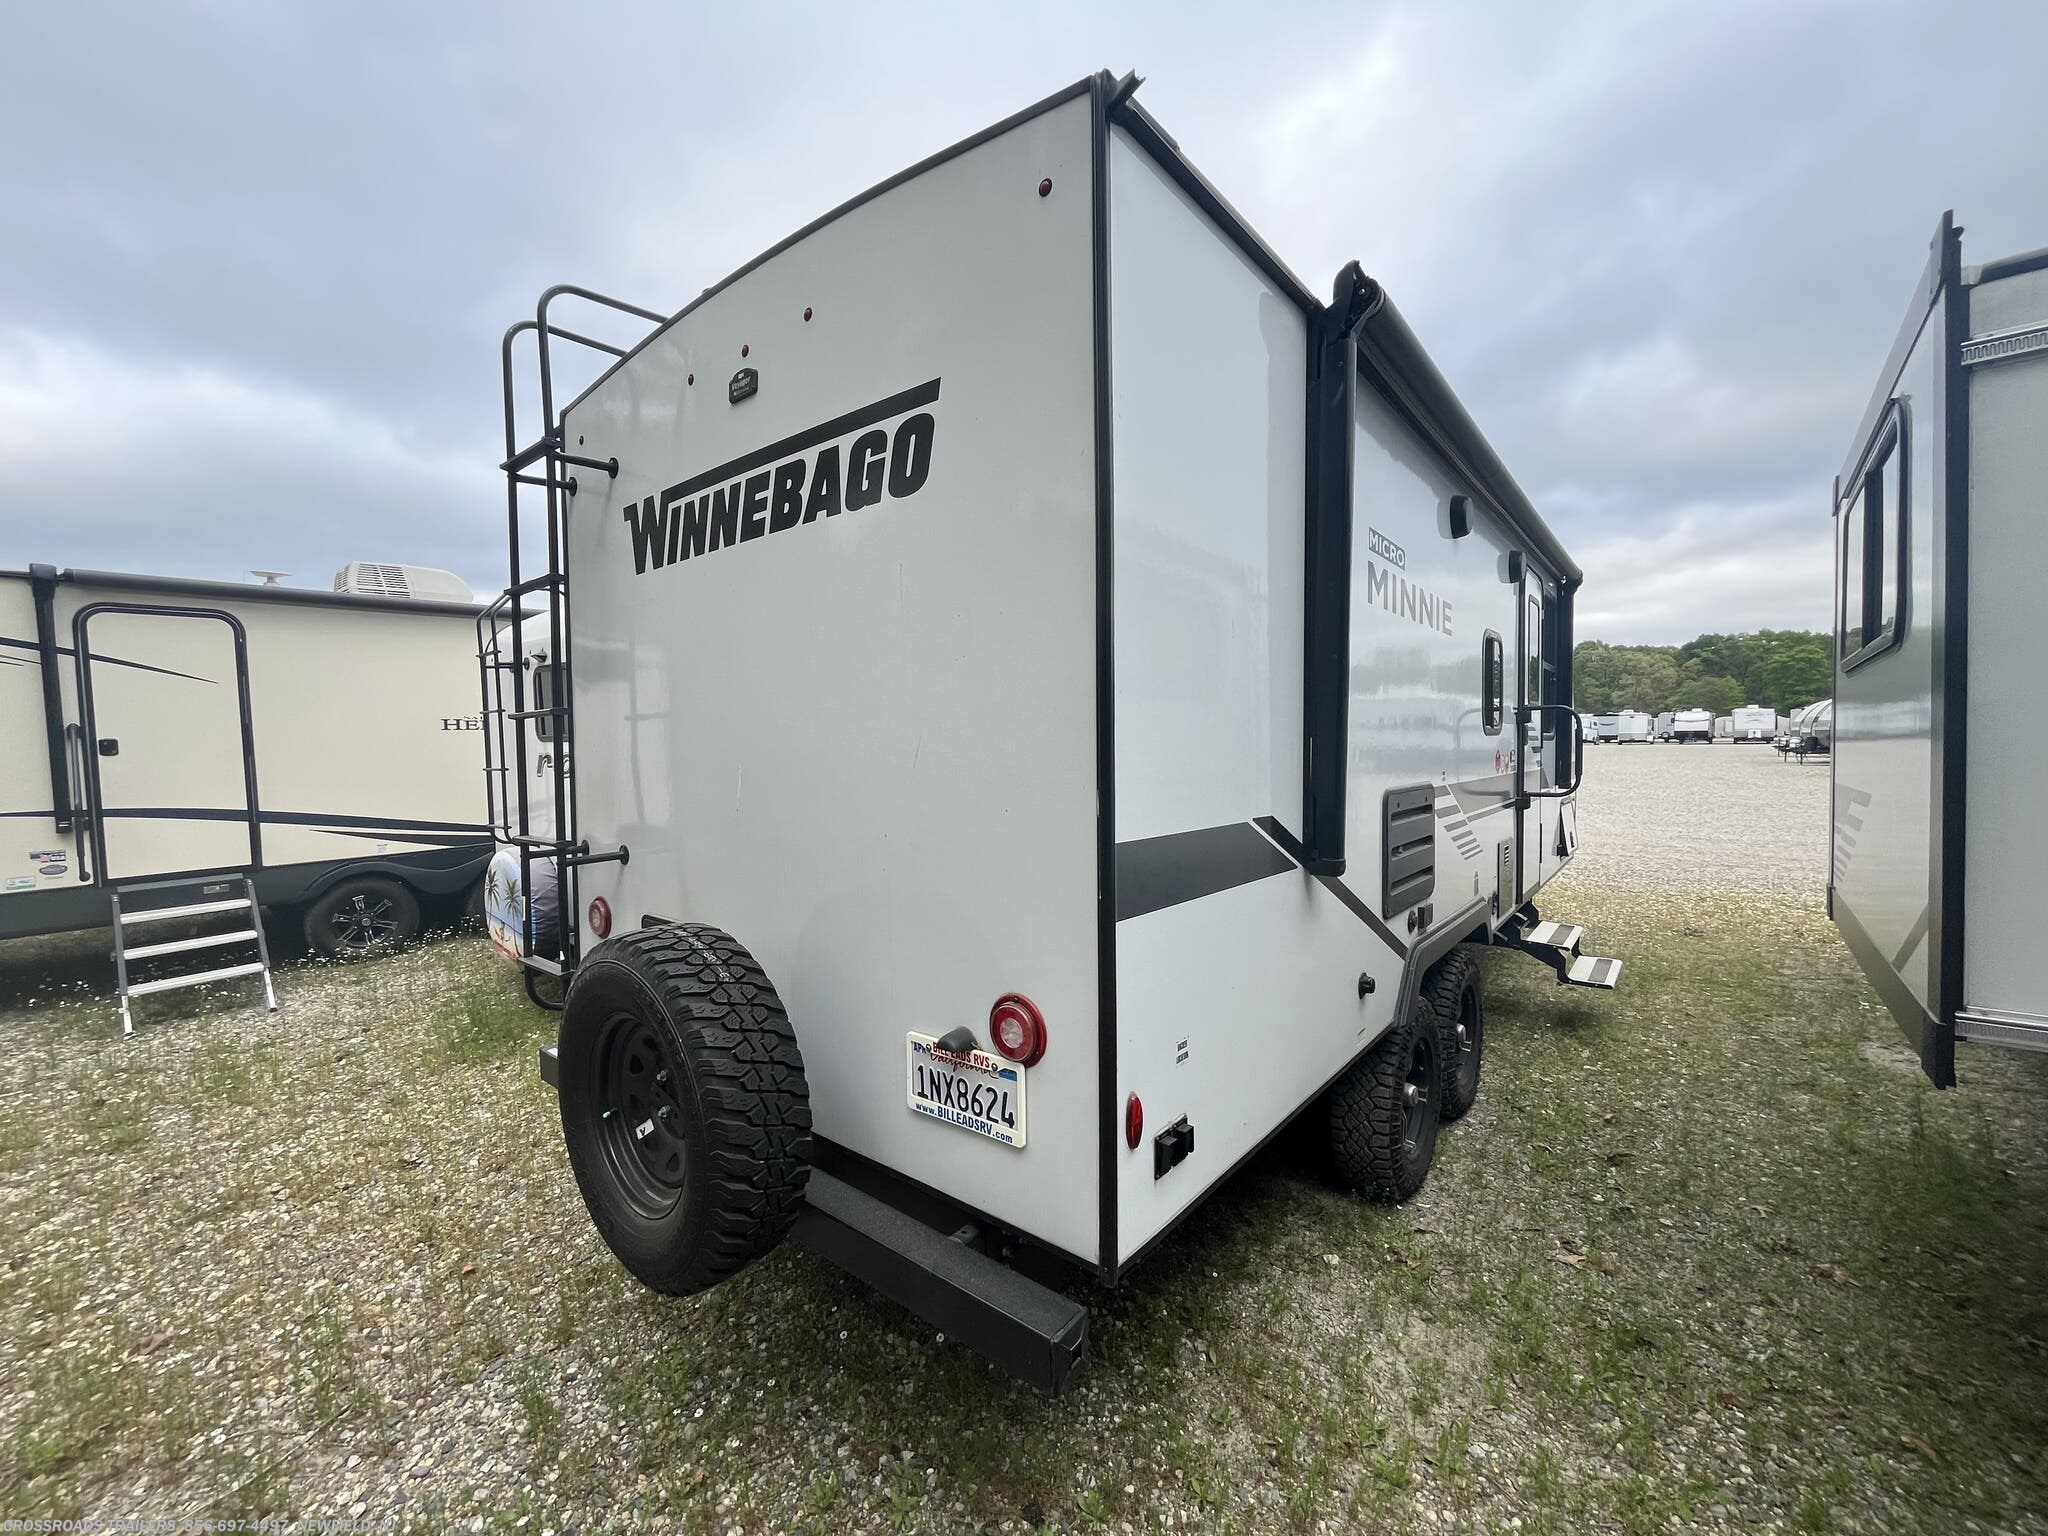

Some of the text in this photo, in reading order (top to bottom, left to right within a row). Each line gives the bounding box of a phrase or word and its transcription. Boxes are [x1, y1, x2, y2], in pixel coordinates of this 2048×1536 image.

[623, 412, 935, 576] WINNEBAGO
[1369, 531, 1405, 567] MICRO
[1367, 560, 1452, 636] MINNIE
[973, 1055, 990, 1069] RVS
[915, 1102, 1013, 1144] www.BILLEADSRV.com
[917, 1065, 1015, 1129] 1NX8624
